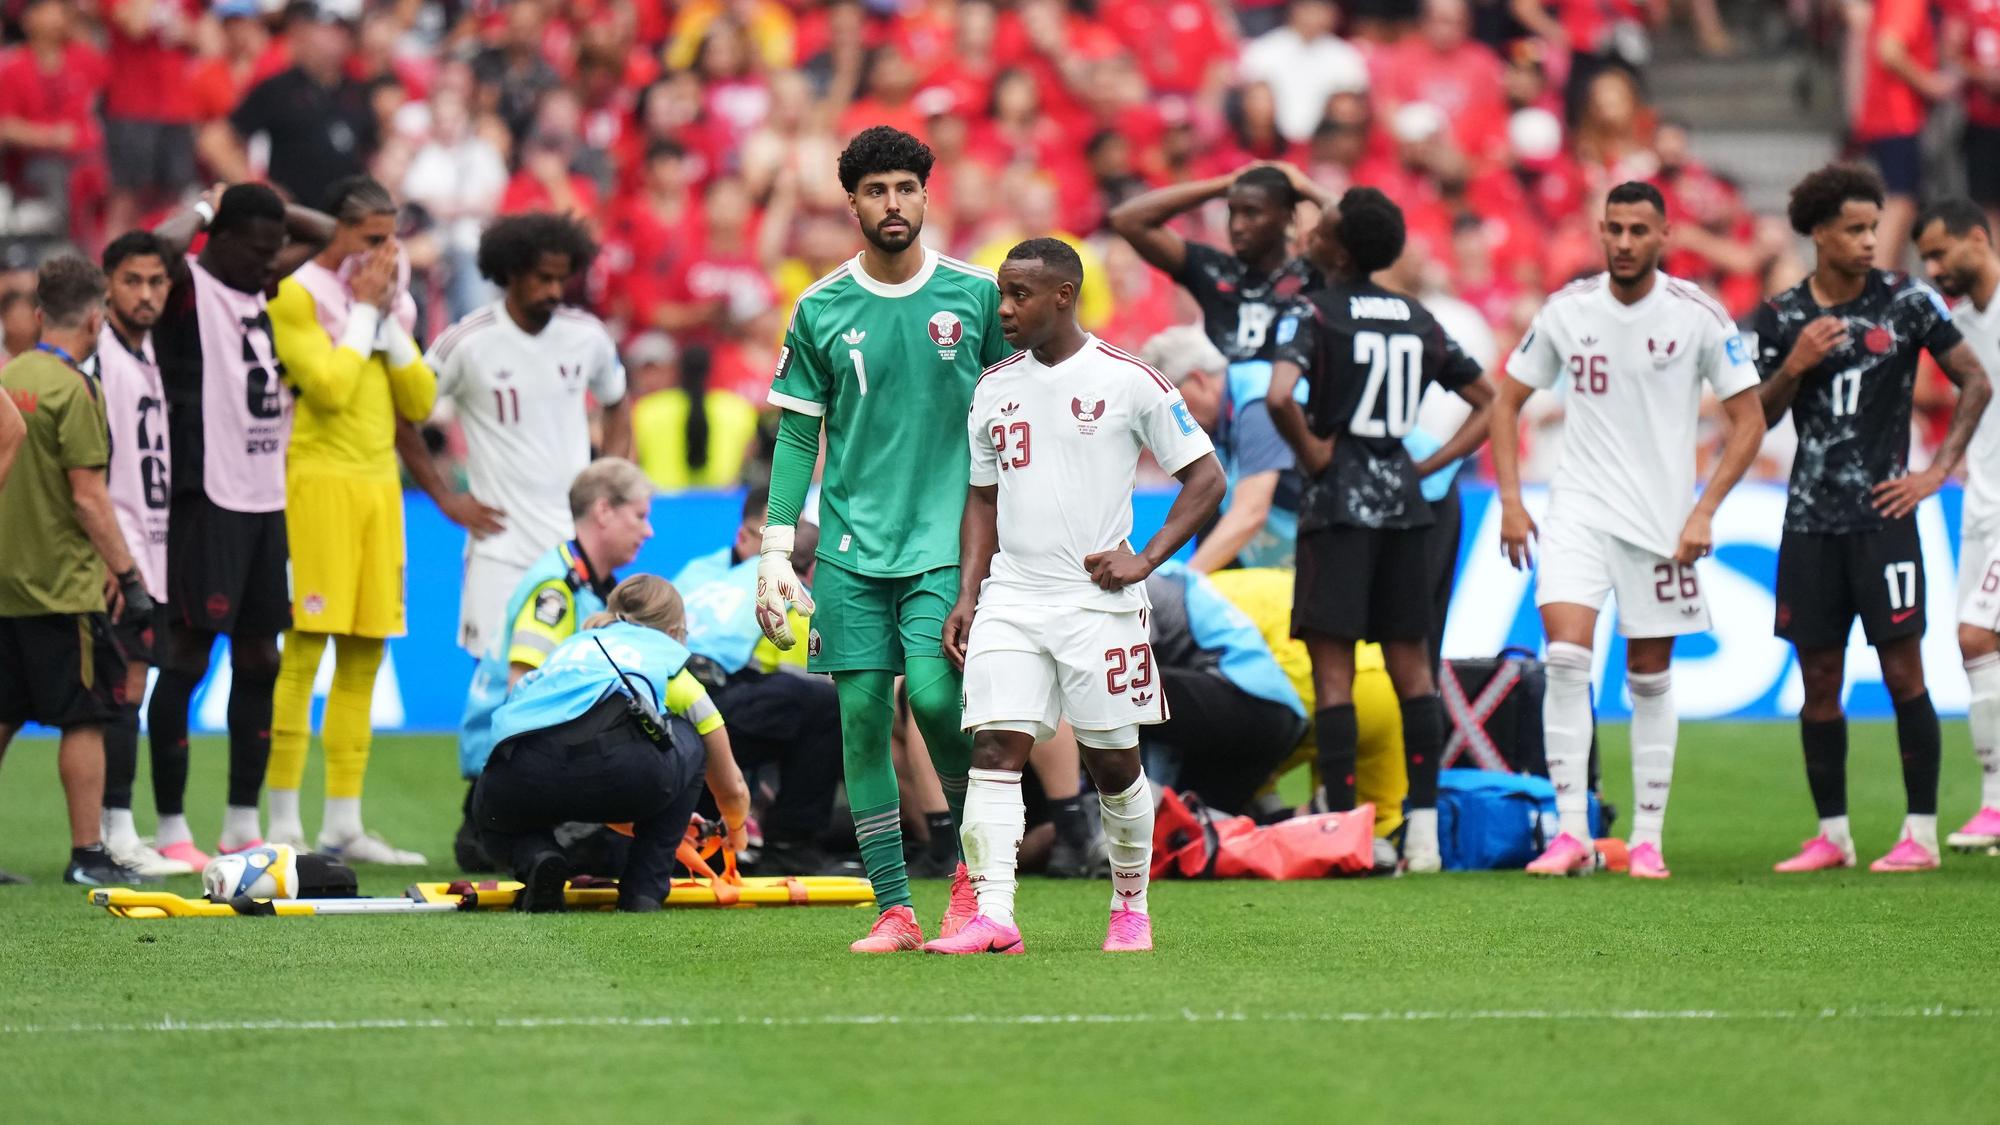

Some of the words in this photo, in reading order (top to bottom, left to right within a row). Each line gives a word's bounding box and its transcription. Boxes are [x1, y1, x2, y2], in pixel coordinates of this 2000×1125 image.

[937, 337, 955, 345] QFA
[848, 349, 868, 397] 1
[1349, 330, 1424, 438] 20
[1570, 355, 1607, 394] 26
[1832, 369, 1863, 416] 17
[494, 387, 520, 424] 11
[991, 421, 1031, 471] 23
[1654, 563, 1698, 602] 26
[1884, 561, 1916, 610] 17
[1104, 643, 1151, 695] 23
